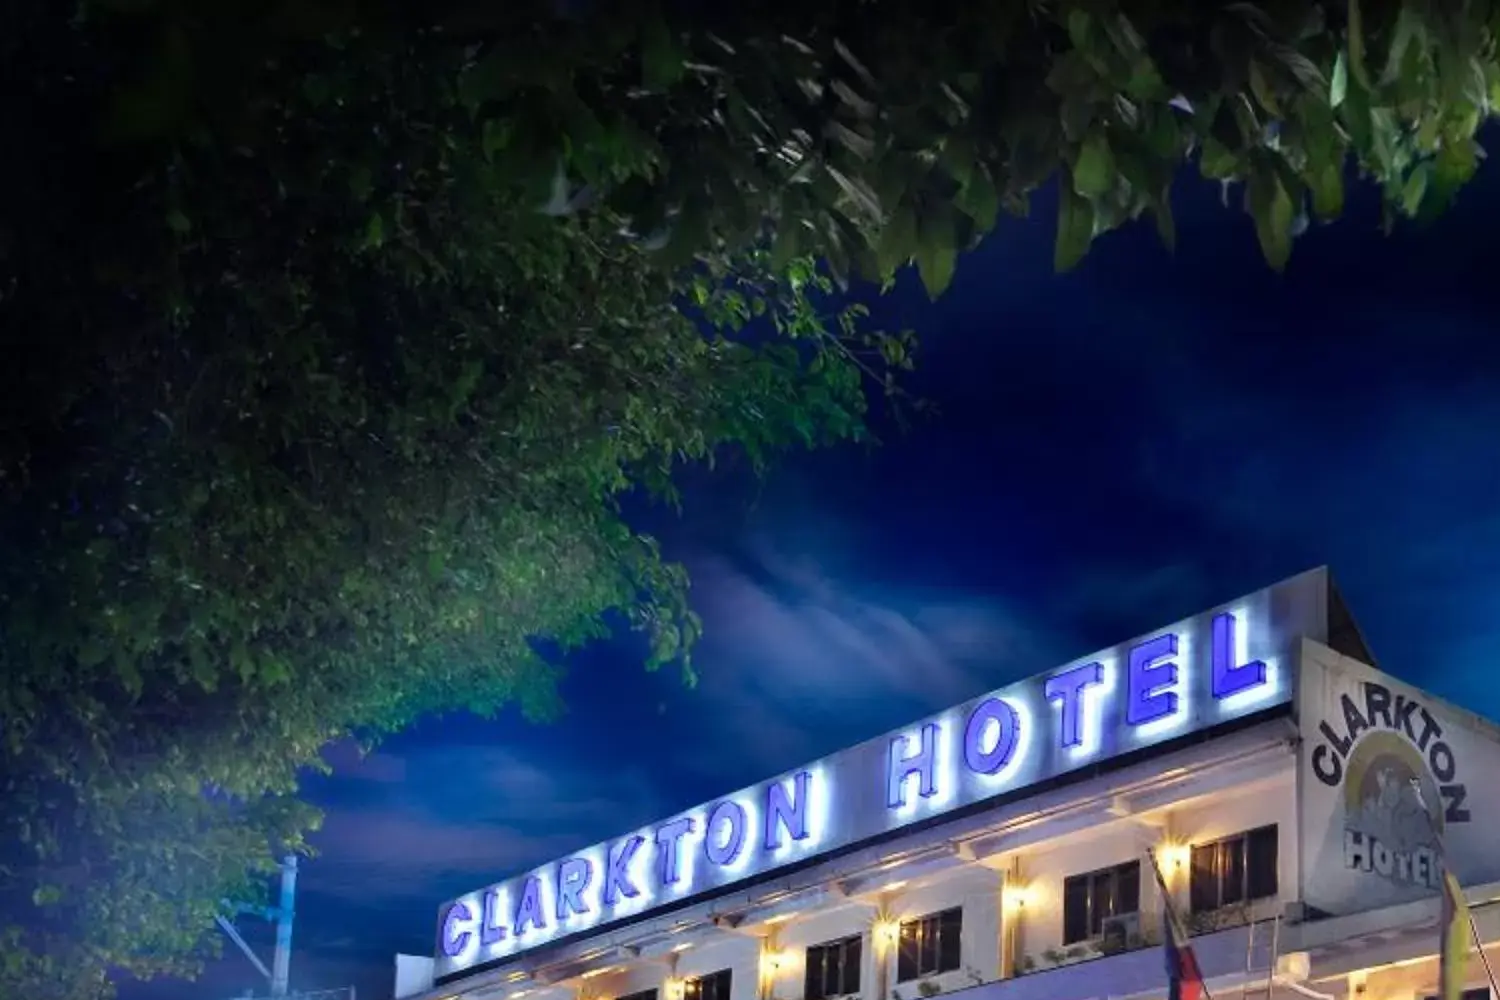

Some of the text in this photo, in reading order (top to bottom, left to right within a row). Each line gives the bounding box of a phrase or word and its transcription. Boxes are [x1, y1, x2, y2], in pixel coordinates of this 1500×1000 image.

[441, 611, 1267, 957] CLARKTON HOTEL
[1312, 682, 1471, 823] CLARKTON
